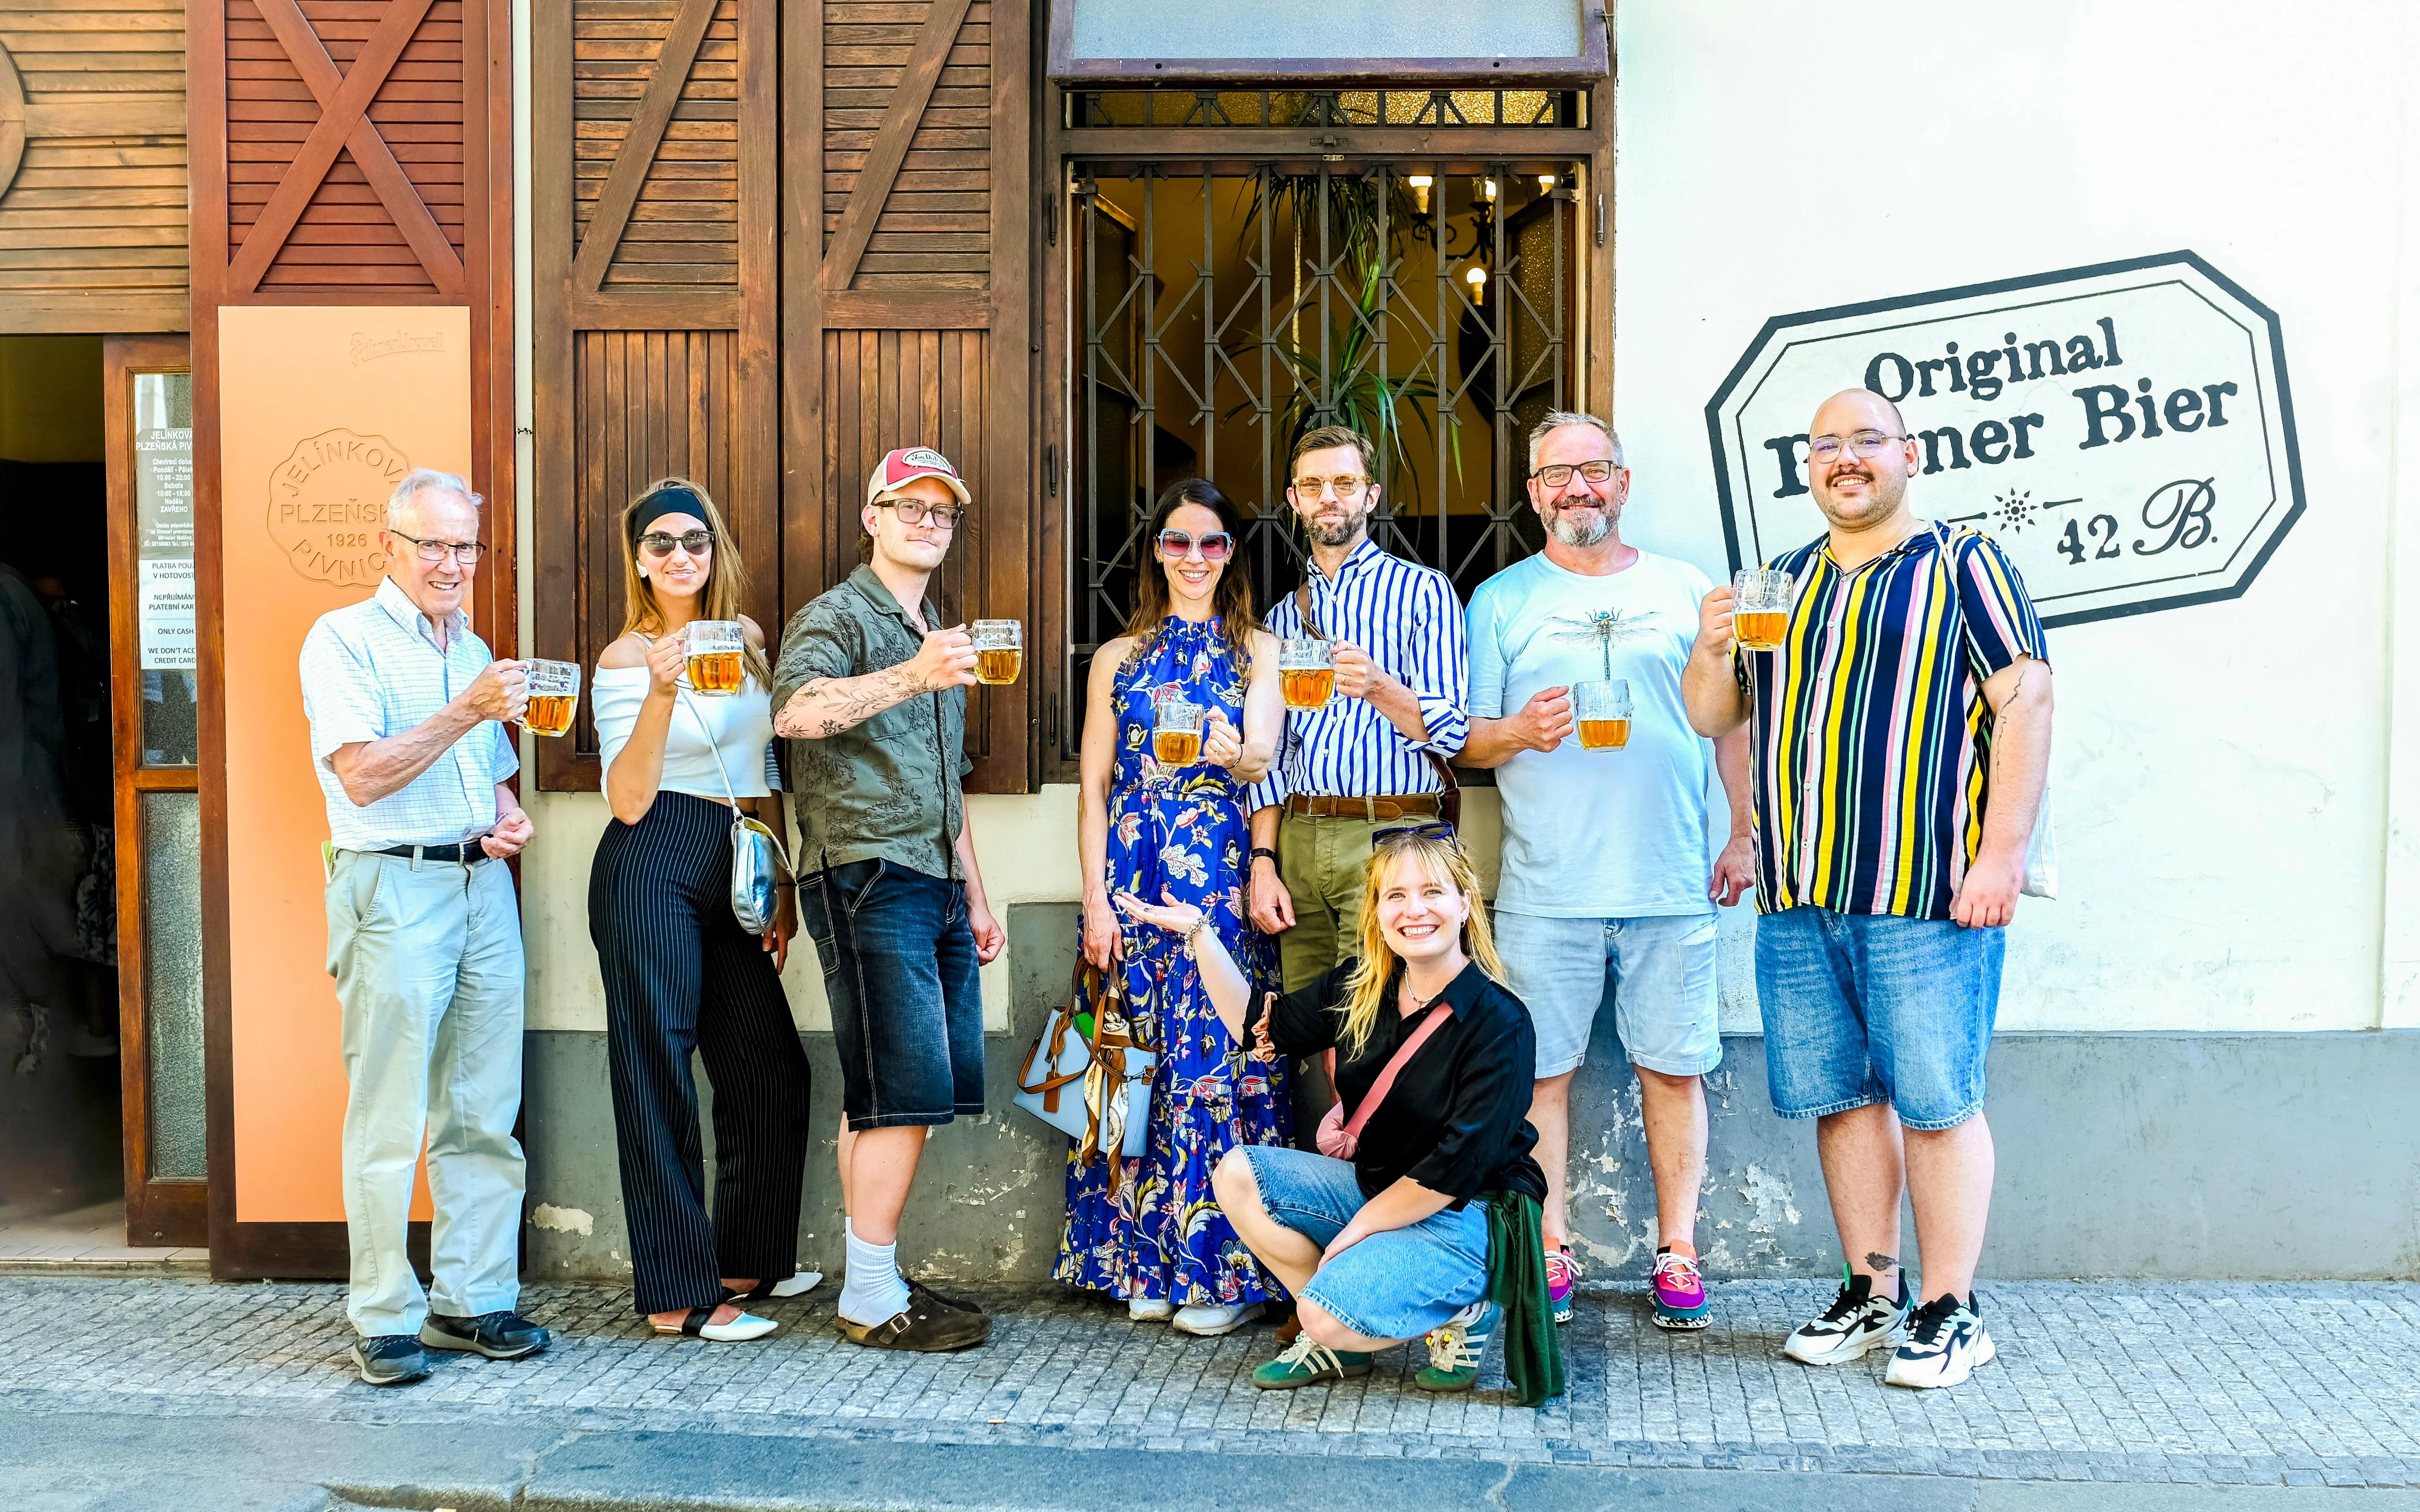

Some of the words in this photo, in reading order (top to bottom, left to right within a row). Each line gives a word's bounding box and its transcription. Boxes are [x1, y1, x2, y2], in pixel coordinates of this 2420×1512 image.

[1865, 317, 2123, 402] Original
[2072, 378, 2238, 449] Bier
[136, 440, 177, 450] PLZEŇSKÁ
[327, 534, 367, 547] 1926
[2057, 515, 2120, 564] 42
